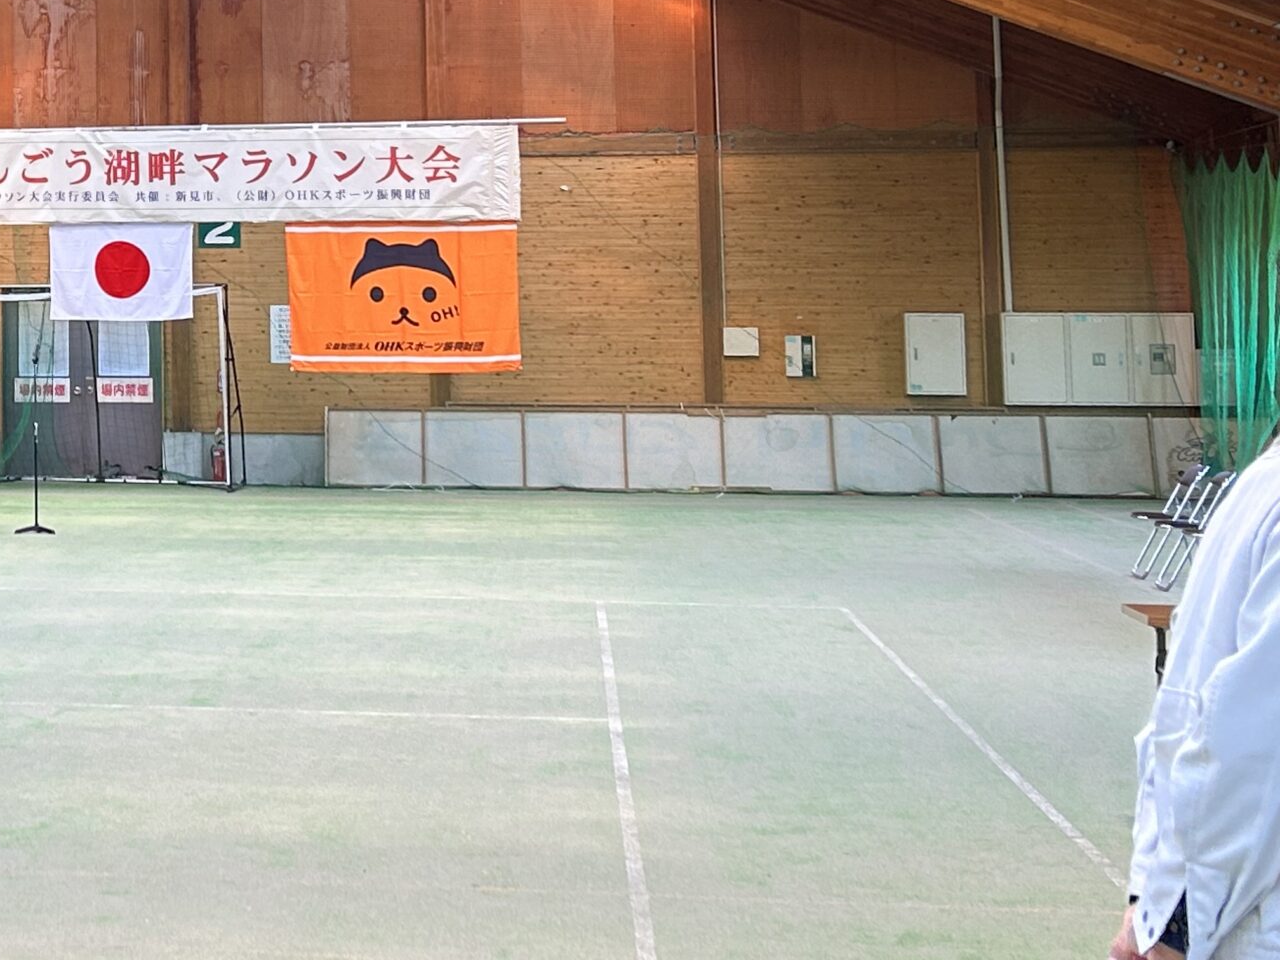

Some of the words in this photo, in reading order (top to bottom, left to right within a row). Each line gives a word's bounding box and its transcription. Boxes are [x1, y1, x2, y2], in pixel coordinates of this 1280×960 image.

[430, 304, 461, 323] OH!
[101, 383, 149, 397] 場内禁煙
